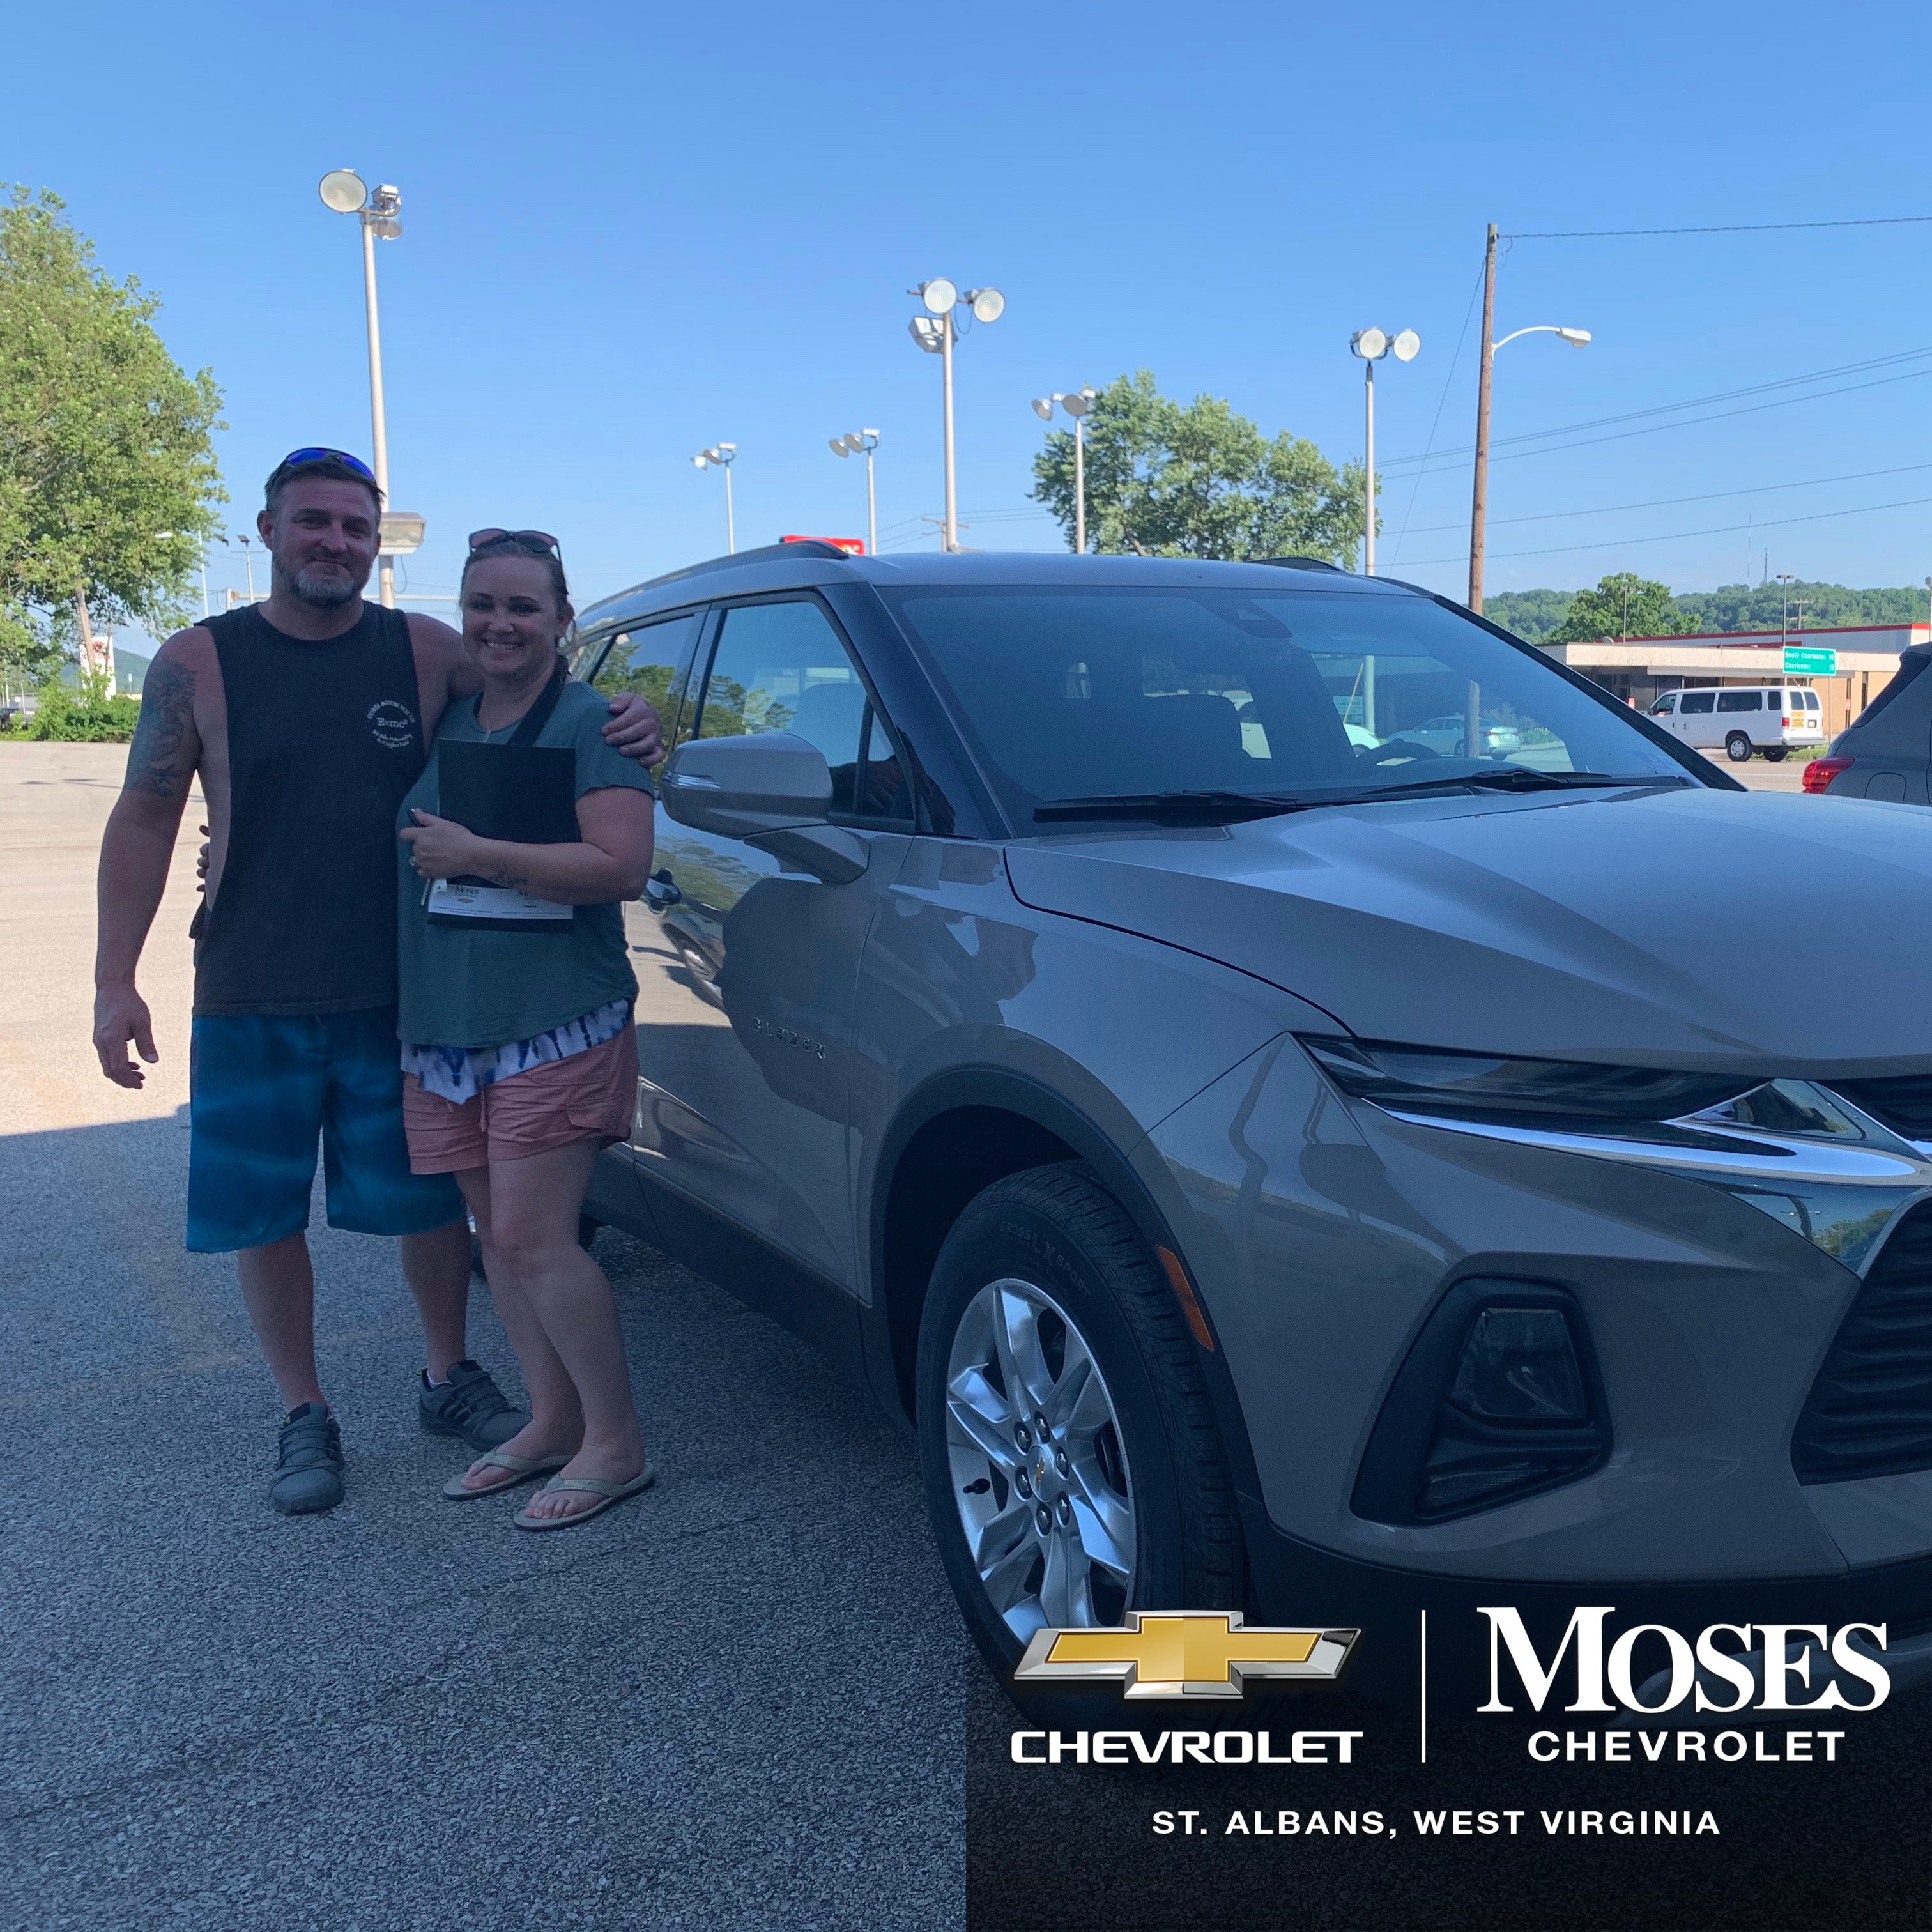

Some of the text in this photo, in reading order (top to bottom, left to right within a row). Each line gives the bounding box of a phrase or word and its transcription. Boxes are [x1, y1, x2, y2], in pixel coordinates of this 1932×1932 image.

[1785, 662, 1810, 670] Charleston
[1000, 1220, 1032, 1241] CROSS
[1055, 1254, 1091, 1299] SPORT
